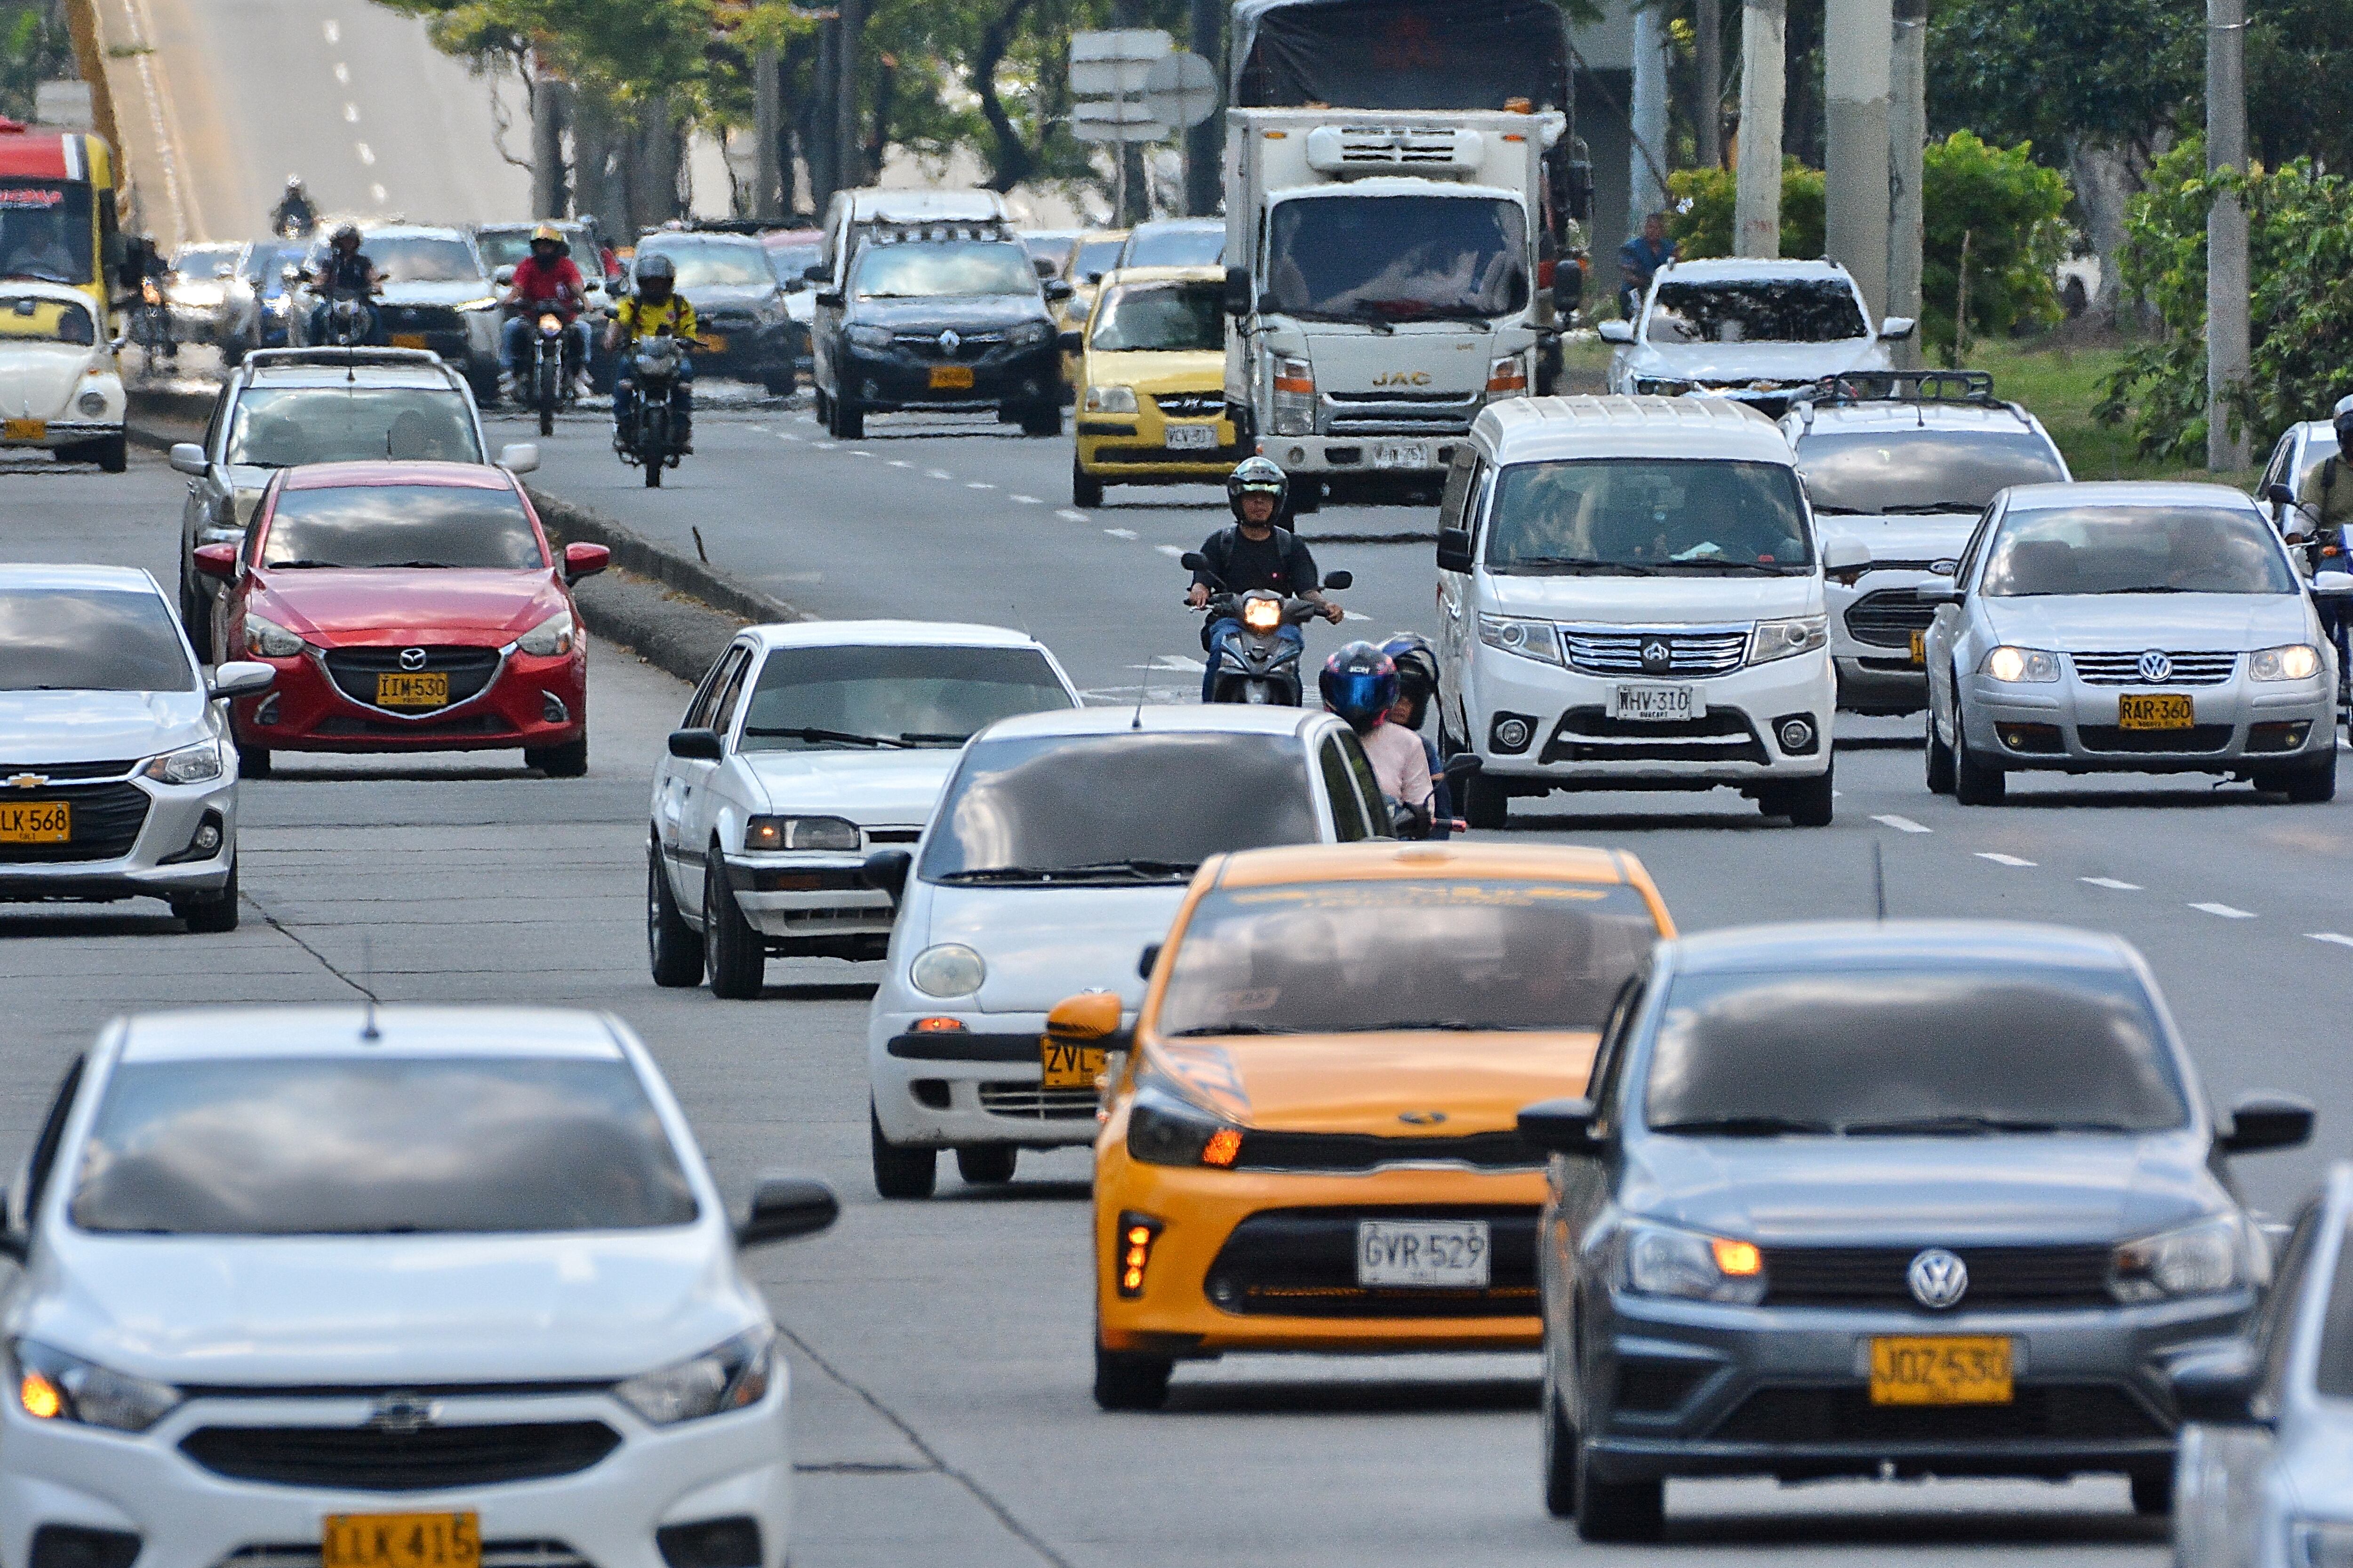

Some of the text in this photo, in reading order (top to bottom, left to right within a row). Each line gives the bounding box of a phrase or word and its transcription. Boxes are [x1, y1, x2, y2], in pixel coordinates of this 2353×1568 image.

[1373, 372, 1432, 386] JAC
[0, 810, 66, 832] LK-568
[1047, 1046, 1106, 1072] ZVL-
